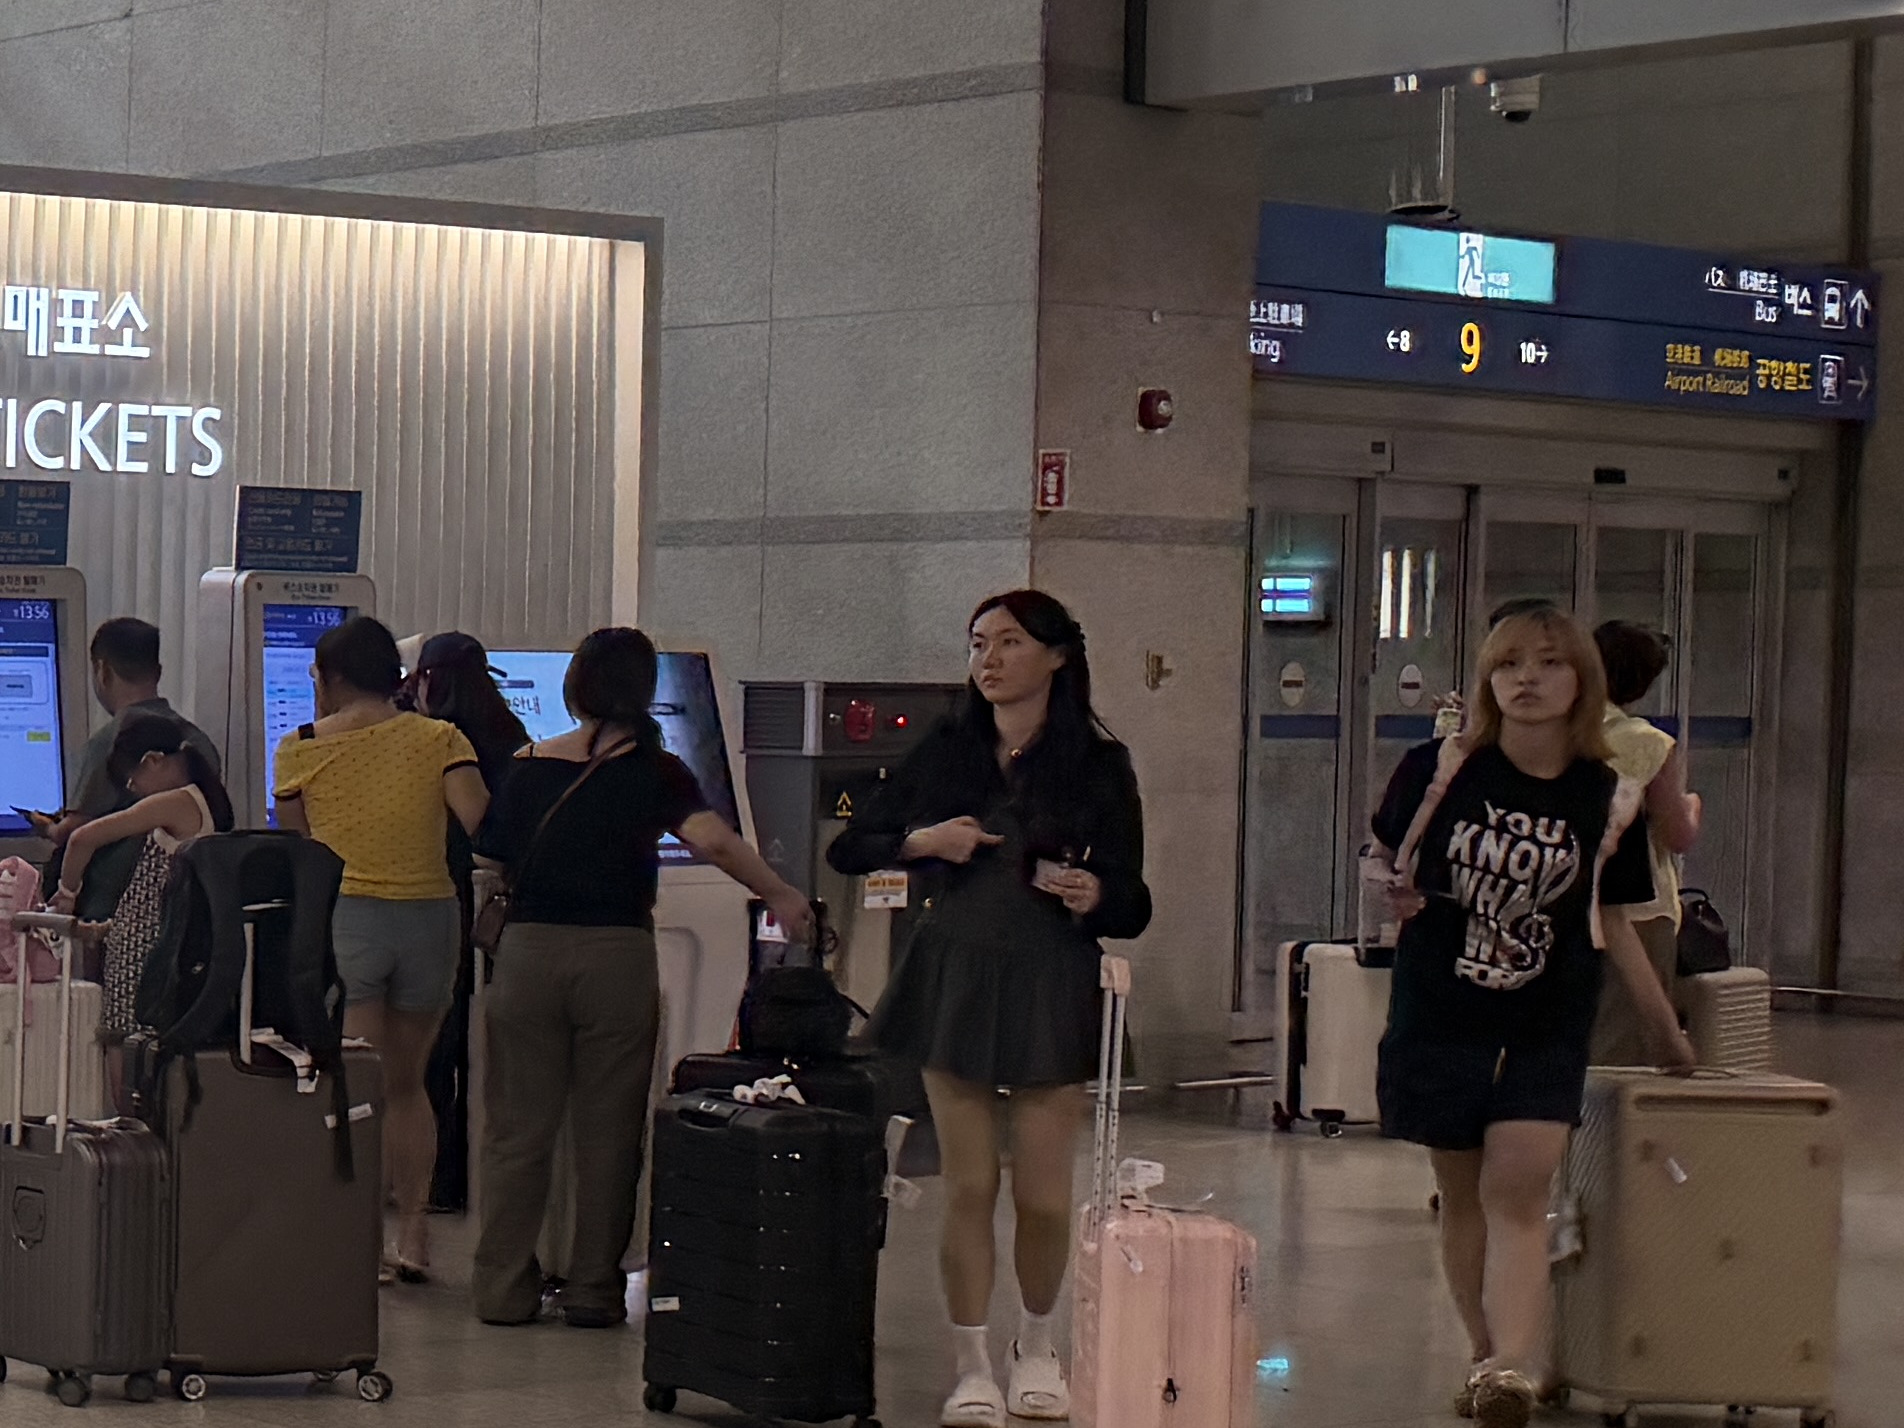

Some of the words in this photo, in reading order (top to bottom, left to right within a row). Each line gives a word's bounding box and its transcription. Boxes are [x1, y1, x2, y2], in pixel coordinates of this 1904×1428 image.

[1755, 300, 1778, 323] Bus
[1785, 284, 1814, 316] 버스
[1400, 330, 1410, 352] 8
[1461, 322, 1482, 374] 9
[1521, 342, 1535, 363] 10
[1665, 371, 1704, 394] Airport
[1706, 374, 1749, 396] Railroad
[1756, 359, 1813, 391] 공항철도
[19, 606, 49, 619] 13:56
[506, 695, 541, 716] 안내
[1484, 800, 1566, 844] YOU
